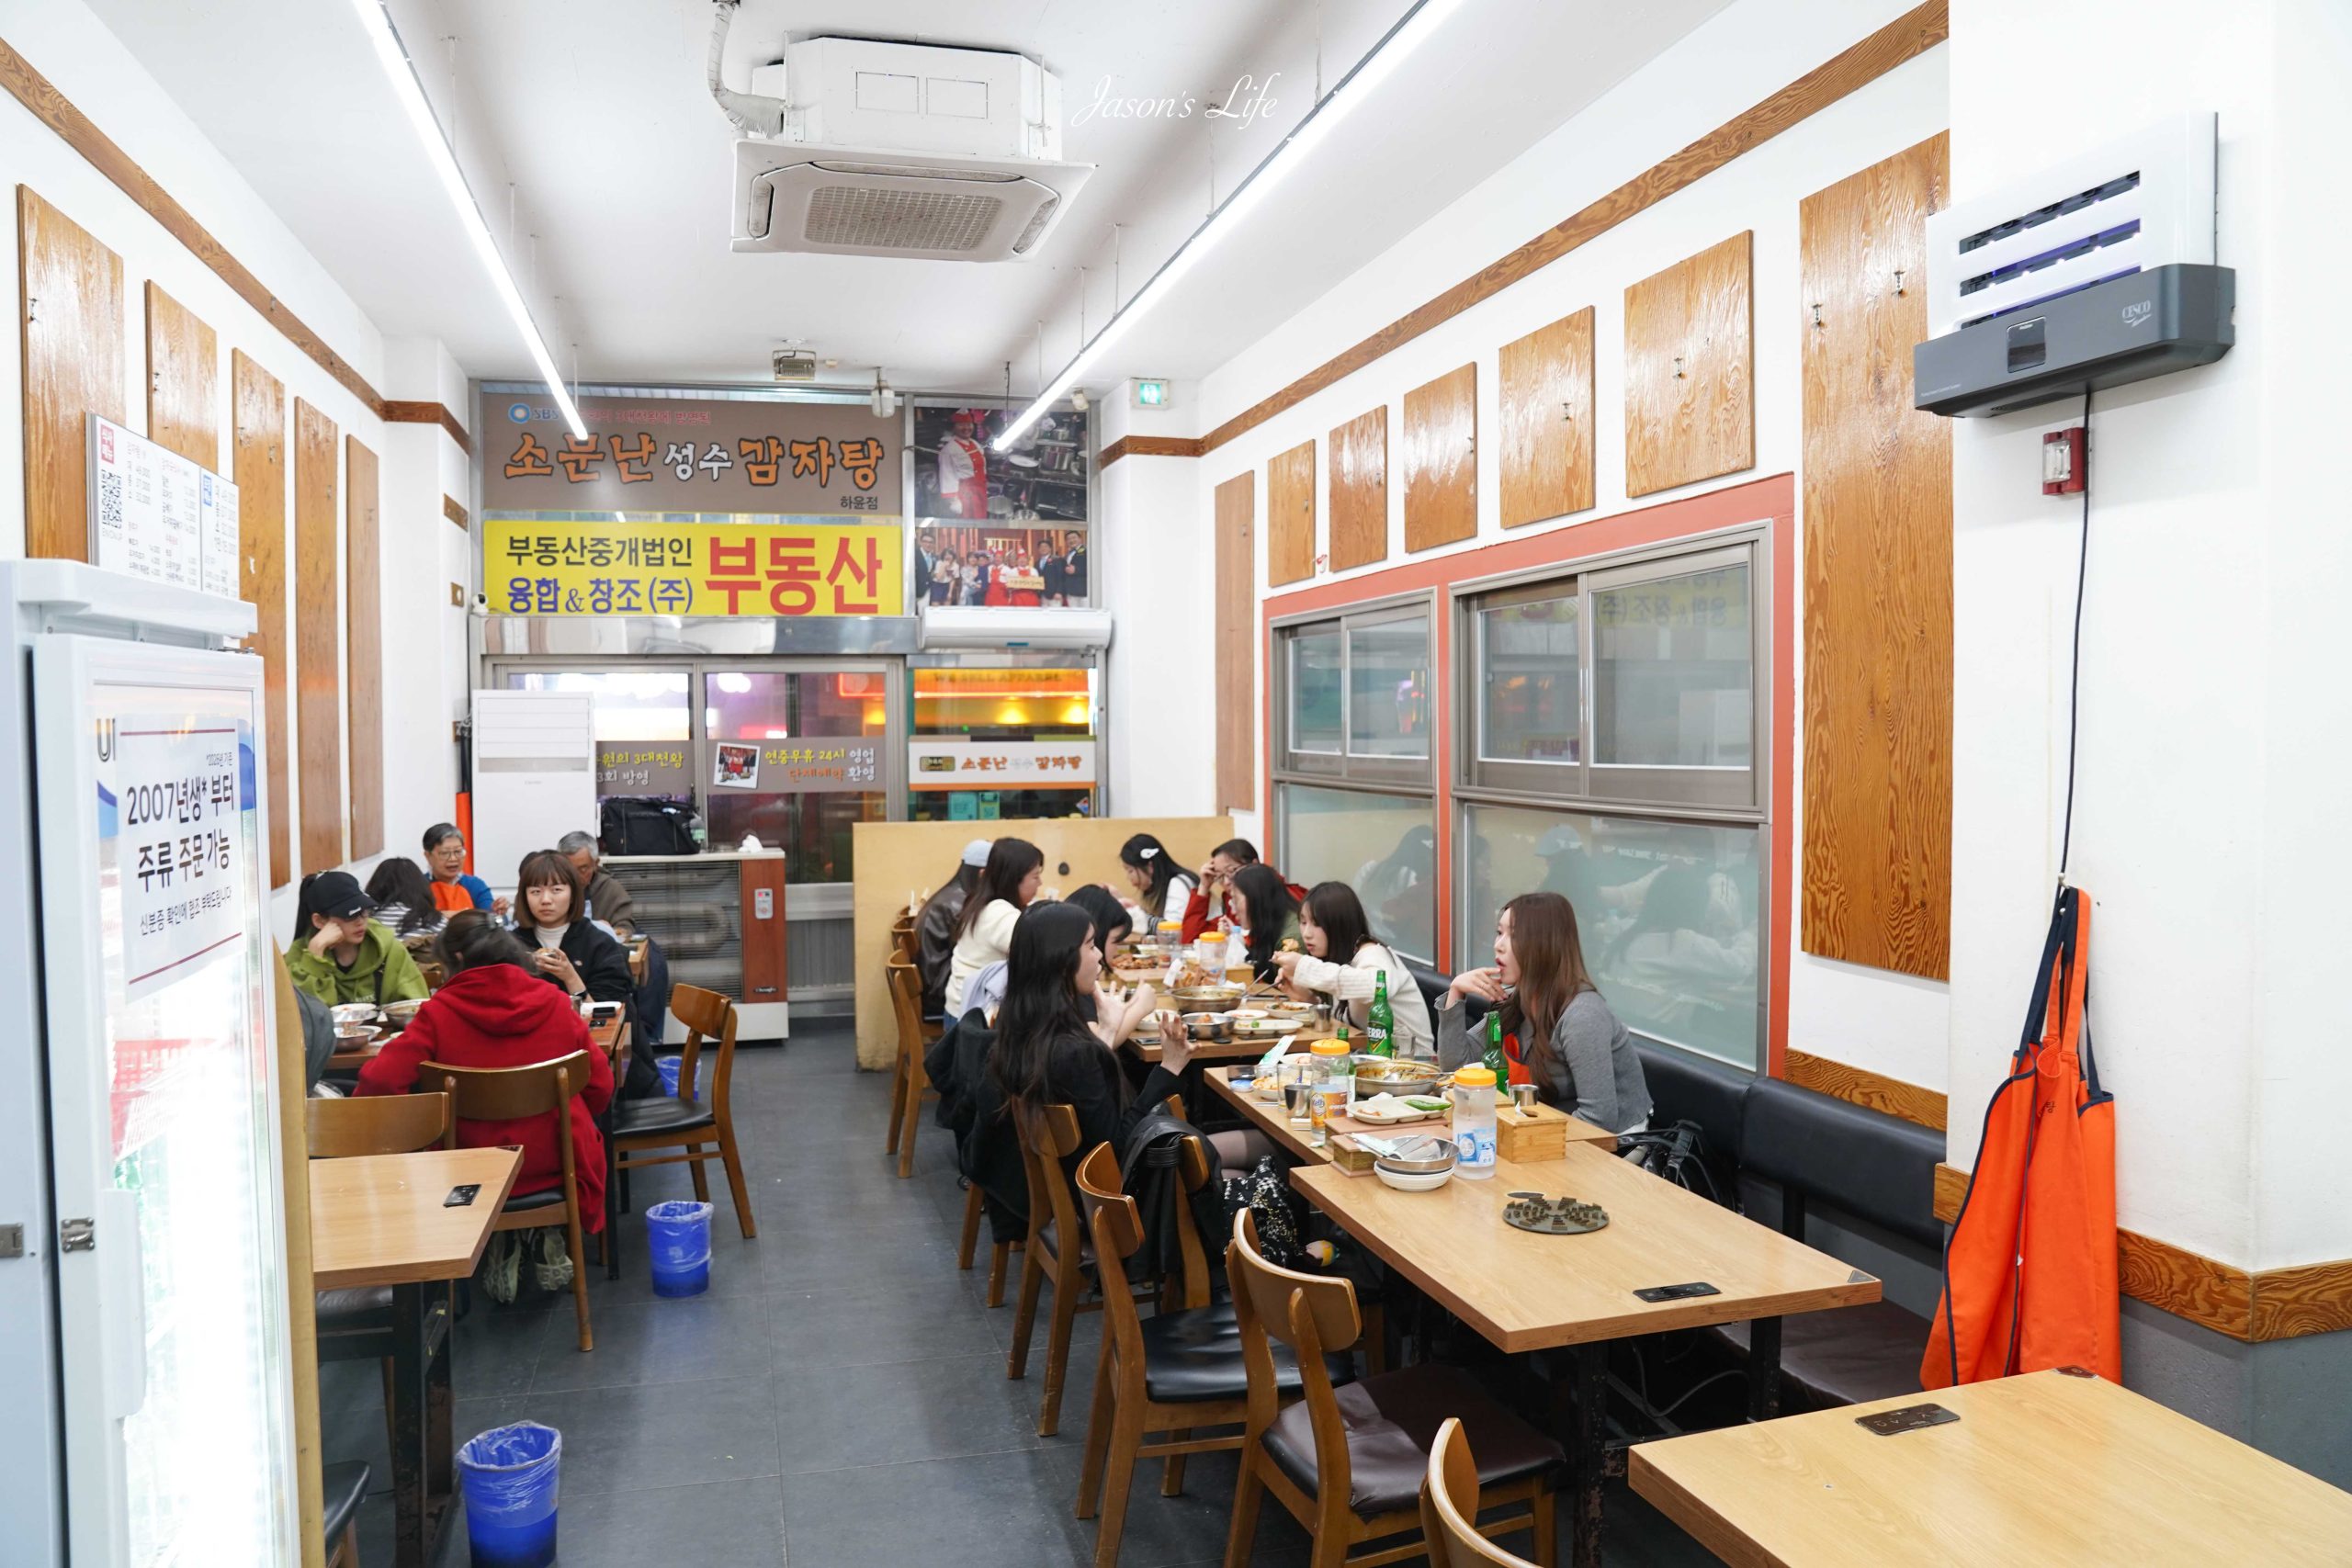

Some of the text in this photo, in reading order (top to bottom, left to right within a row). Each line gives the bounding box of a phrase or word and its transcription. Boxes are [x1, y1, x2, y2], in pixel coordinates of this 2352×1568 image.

[2122, 300, 2151, 321] CESCO
[533, 408, 560, 420] SBS
[504, 432, 884, 491] 소문난 성수 감자탕
[840, 495, 879, 511] 하윤점
[506, 536, 693, 568] 부동산중개법인
[705, 536, 883, 616] 부동산
[596, 751, 629, 769] 원의
[764, 748, 876, 765] 연중무휴 24시 영업
[623, 770, 650, 785] 방영
[789, 766, 876, 784] 단체예약 환영
[211, 772, 234, 817] 부터
[138, 828, 231, 893] 주류 주문 가능
[140, 886, 232, 936] 신분증 확인에 협조 부탁드립니다
